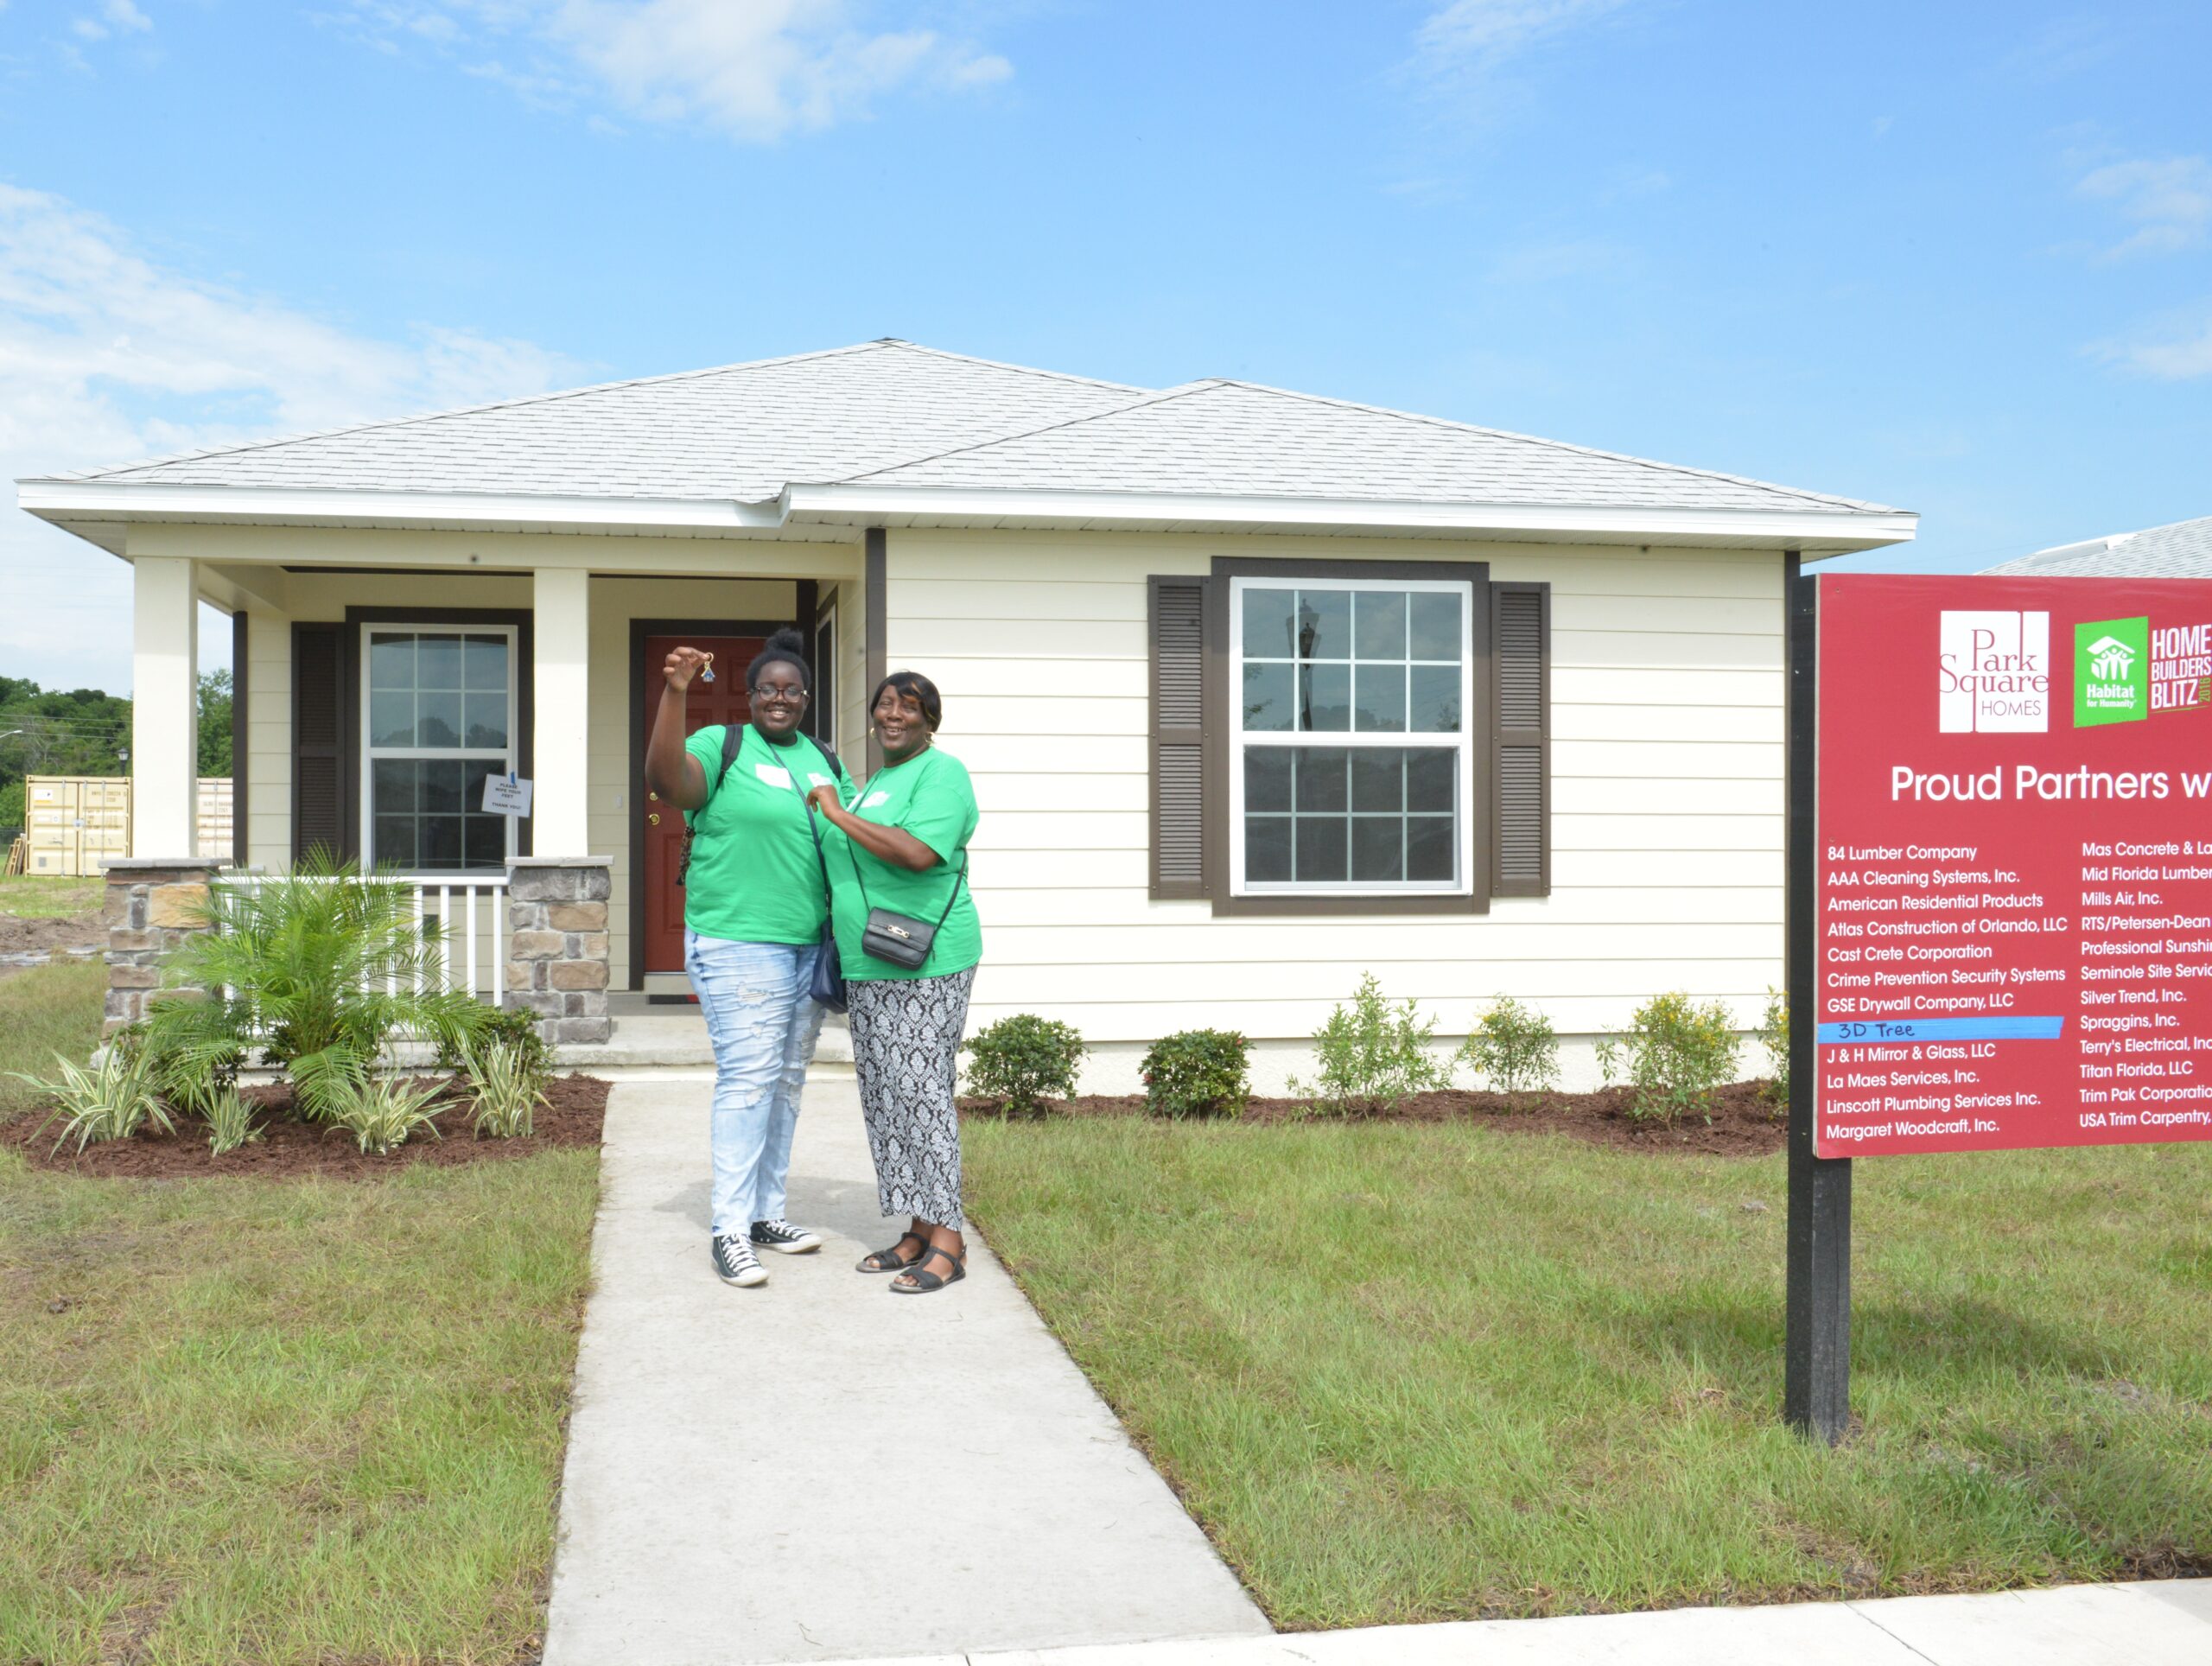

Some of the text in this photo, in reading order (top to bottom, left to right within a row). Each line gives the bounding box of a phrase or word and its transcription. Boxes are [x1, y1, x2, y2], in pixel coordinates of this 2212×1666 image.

[1971, 628, 2037, 671] Park
[2152, 624, 2212, 660] HOME
[1940, 653, 2049, 694] Square
[2152, 657, 2212, 681] BUILDERS
[2087, 684, 2135, 699] Habitat
[2152, 679, 2198, 709] BLITZ
[2199, 677, 2210, 702] 2016
[1981, 701, 2041, 716] HOMES
[2099, 698, 2134, 709] Humanity
[1892, 766, 2001, 800] Proud
[2017, 765, 2169, 799] Partners
[1828, 845, 1977, 862] 84 Lumber Company
[2082, 843, 2111, 856] Mas
[2115, 842, 2179, 855] Concrete
[2183, 842, 2193, 855] &
[1827, 869, 2019, 887] AAA Cleaning Systems, Inc.
[2082, 868, 2107, 881] Mid
[2113, 867, 2158, 881] Florida
[1827, 893, 2043, 911] American Residential Products
[2082, 892, 2163, 906] Mills Air, Inc.
[1828, 918, 2067, 936] Atlas Construction of Orlando, LLC
[2082, 915, 2210, 932] RTS/Petersen-Dean
[1827, 944, 1992, 962] Cast Crete Corporation
[2082, 940, 2162, 955] Professional
[1827, 968, 2065, 987] Crime Prevention Security Systems
[2082, 965, 2144, 980] Seminole
[2148, 964, 2171, 978] Site
[1827, 993, 2013, 1014] GSE Drywall Company, LLC
[2081, 989, 2186, 1004] Silver Trend, Inc.
[1839, 1023, 1915, 1039] 3D Tree
[2081, 1014, 2179, 1032] Spraggins, Inc.
[1827, 1043, 1995, 1063] J & H Mirror & Glass, LLC
[2080, 1040, 2121, 1055] Terry's
[2126, 1037, 2190, 1052] Electrical,
[2080, 1061, 2192, 1078] Titan Florida, LLC
[1827, 1070, 1980, 1088] La Maes Services, Inc.
[1827, 1092, 2040, 1114] Linscott Plumbing Services Inc.
[2080, 1090, 2107, 1103] Trim
[2112, 1088, 2135, 1101] Pak
[2080, 1110, 2211, 1127] USA Trim Carpentry,
[1827, 1118, 1999, 1141] Margaret Woodcraft, Inc.
